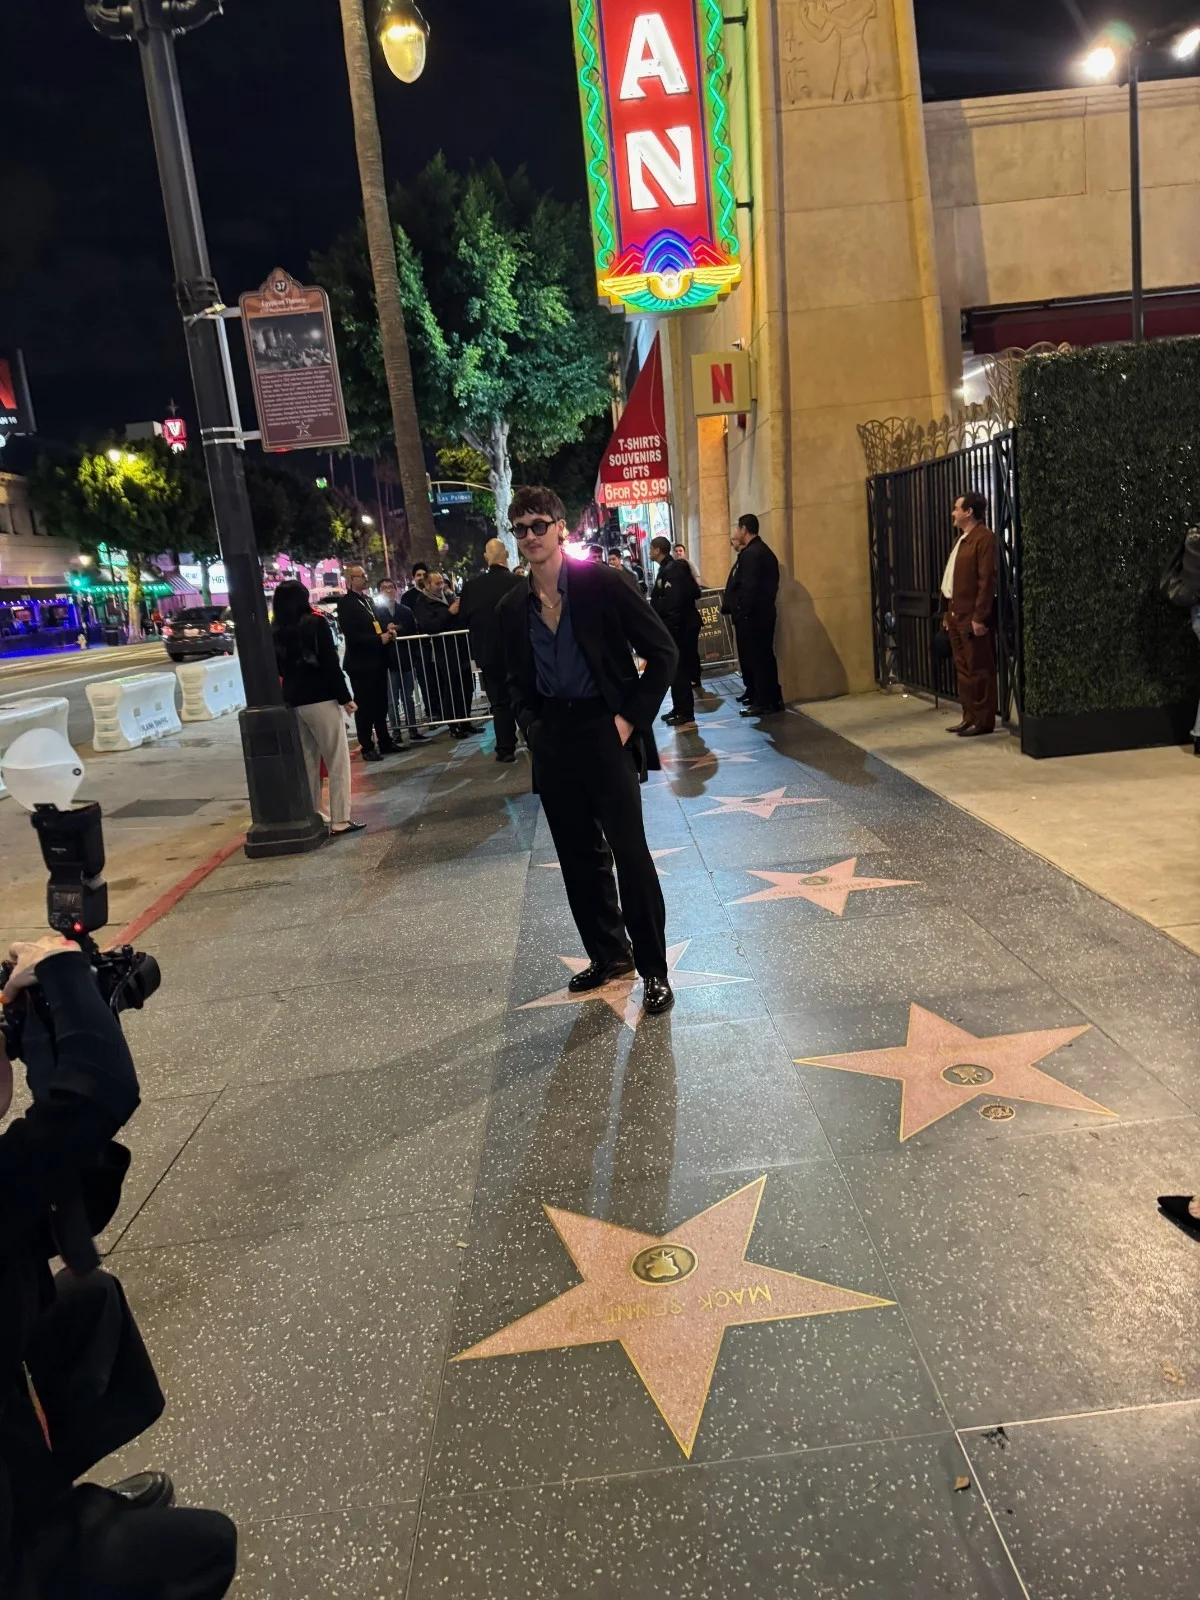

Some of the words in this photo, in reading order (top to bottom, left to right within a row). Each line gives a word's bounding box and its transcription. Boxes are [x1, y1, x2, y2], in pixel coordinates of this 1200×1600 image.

[276, 281, 286, 291] 37
[711, 363, 734, 404] N
[618, 434, 661, 452] T-SHIRTS
[609, 449, 662, 467] SOUVENIRS
[623, 465, 650, 479] GIFTS
[632, 478, 668, 500] $9.99
[700, 606, 720, 616] FLIX
[701, 614, 718, 625] ORE
[700, 1284, 772, 1310] MACK
